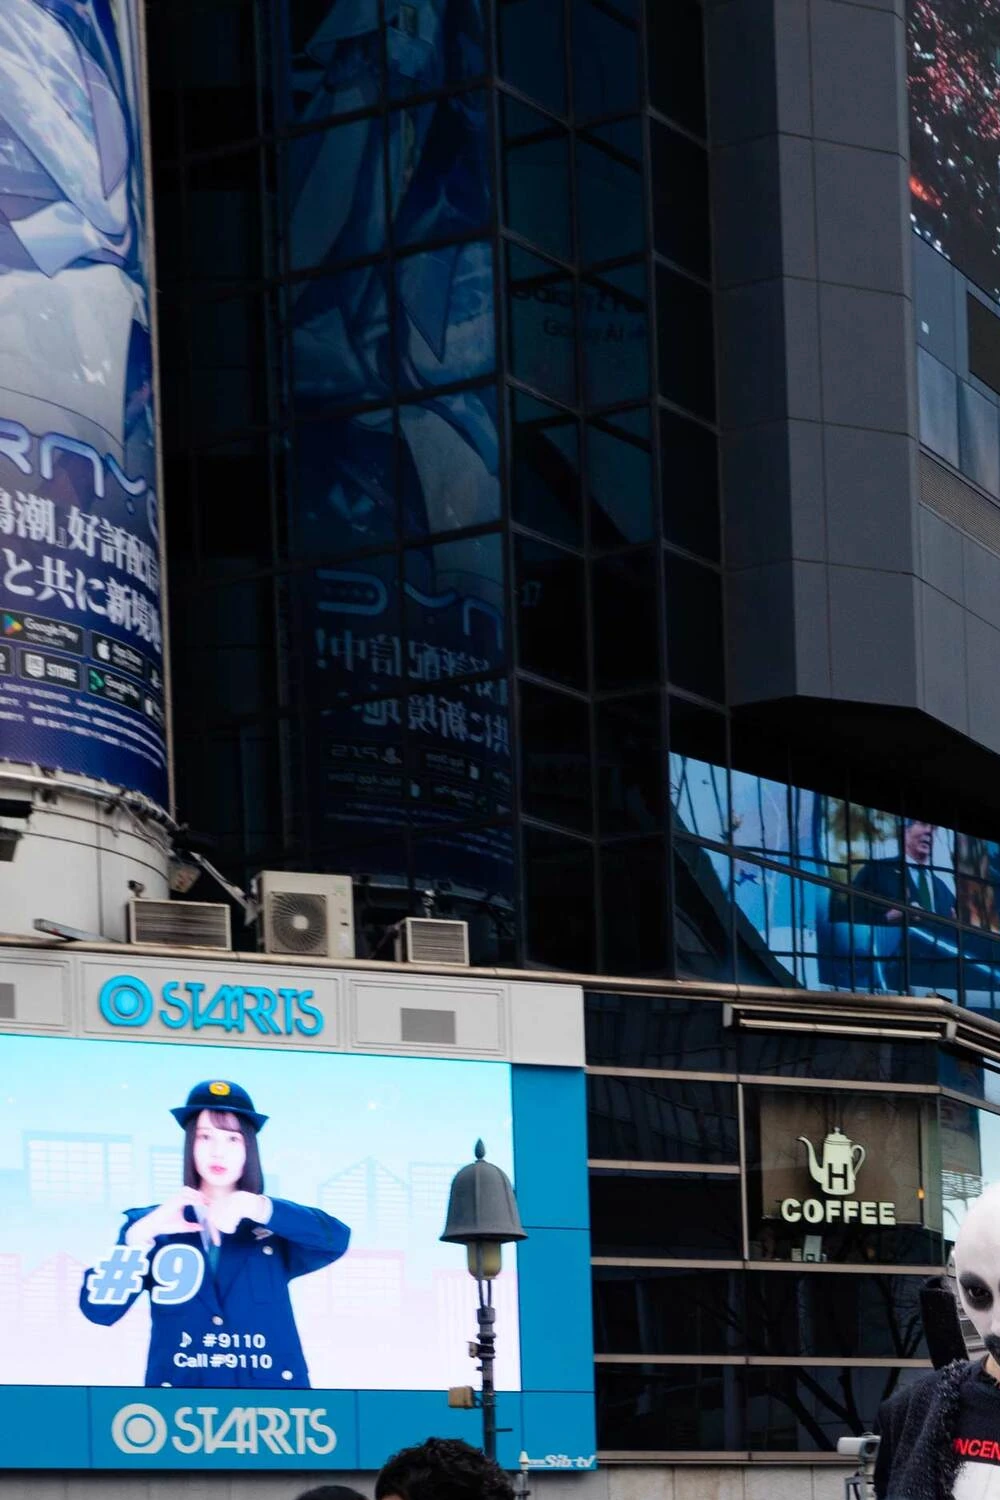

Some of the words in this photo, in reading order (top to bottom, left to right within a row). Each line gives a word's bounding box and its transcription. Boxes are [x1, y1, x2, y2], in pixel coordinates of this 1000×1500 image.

[781, 1198, 897, 1226] COFFEE
[86, 1245, 204, 1305] #9
[202, 1332, 266, 1349] #9110
